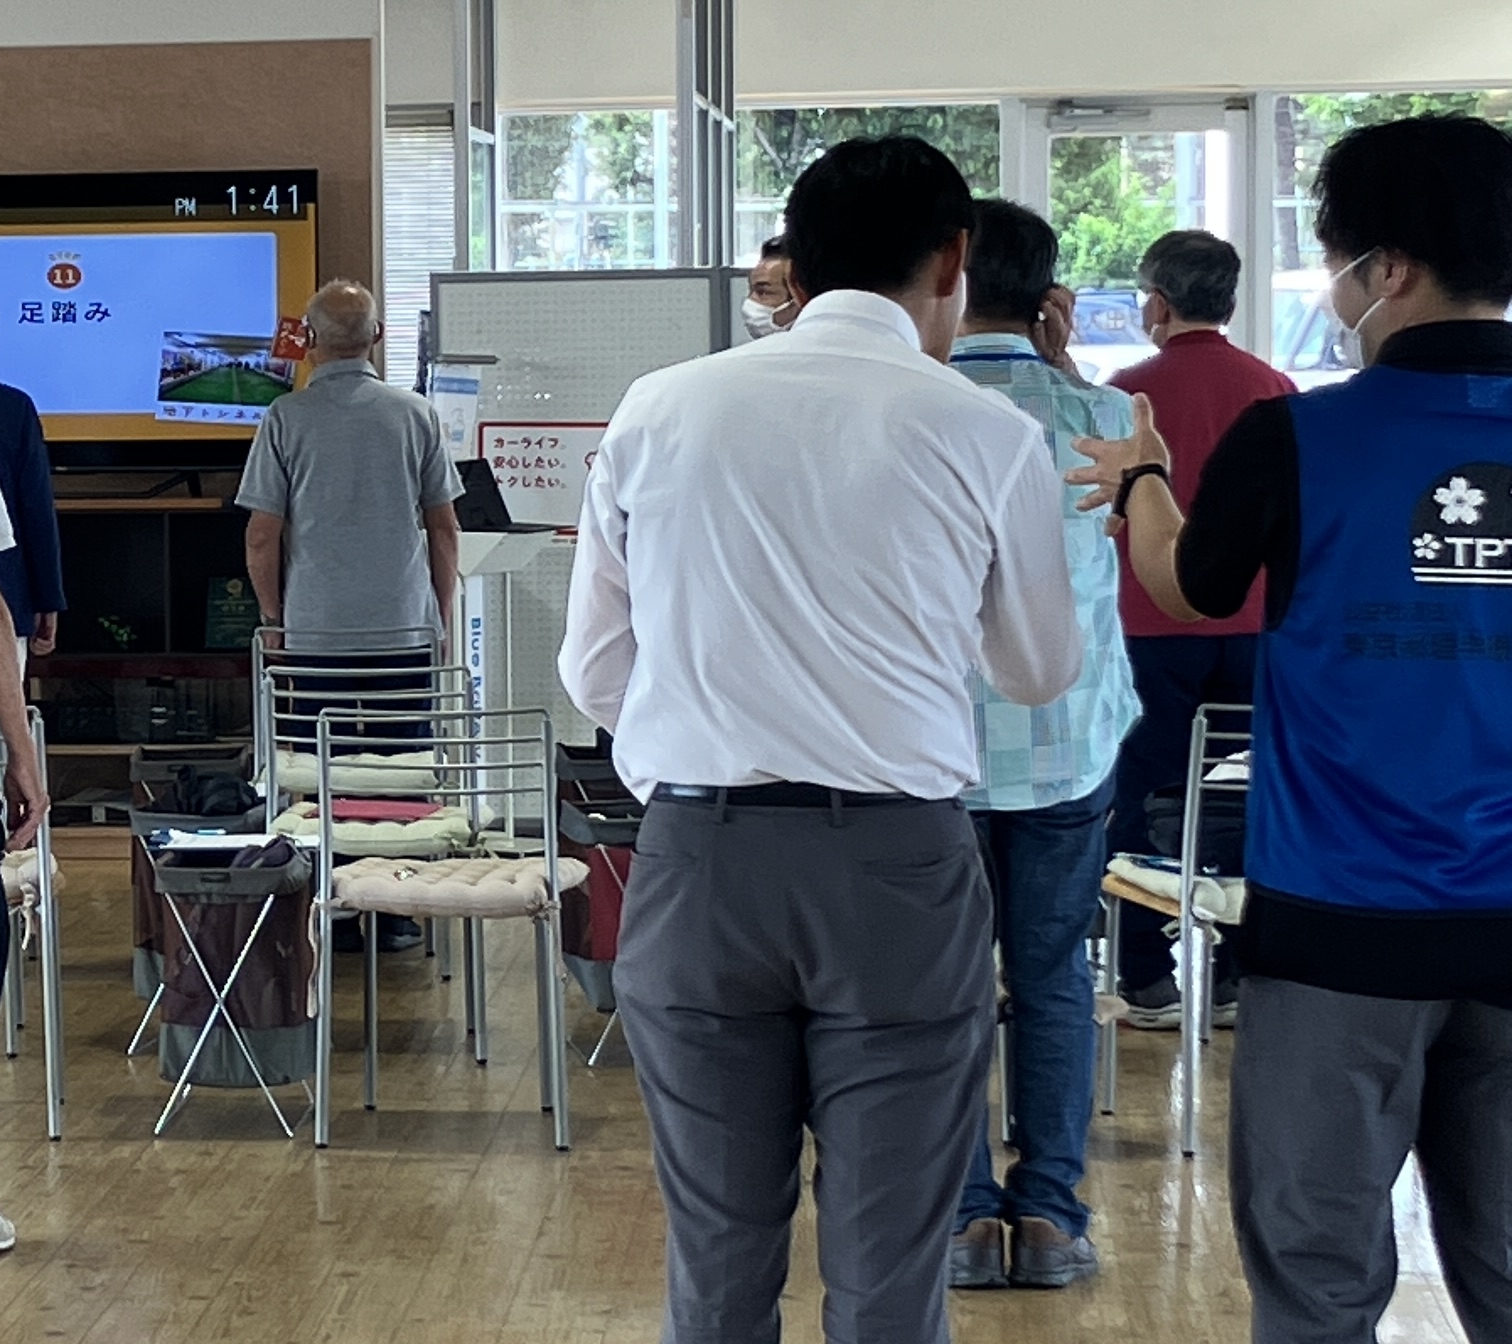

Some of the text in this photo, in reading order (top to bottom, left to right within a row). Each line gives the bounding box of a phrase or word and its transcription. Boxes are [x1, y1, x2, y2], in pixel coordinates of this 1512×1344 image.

[174, 184, 298, 216] PM 1:41
[53, 269, 76, 284] 11
[18, 301, 112, 324] 足踏み
[471, 617, 482, 667] Blue
